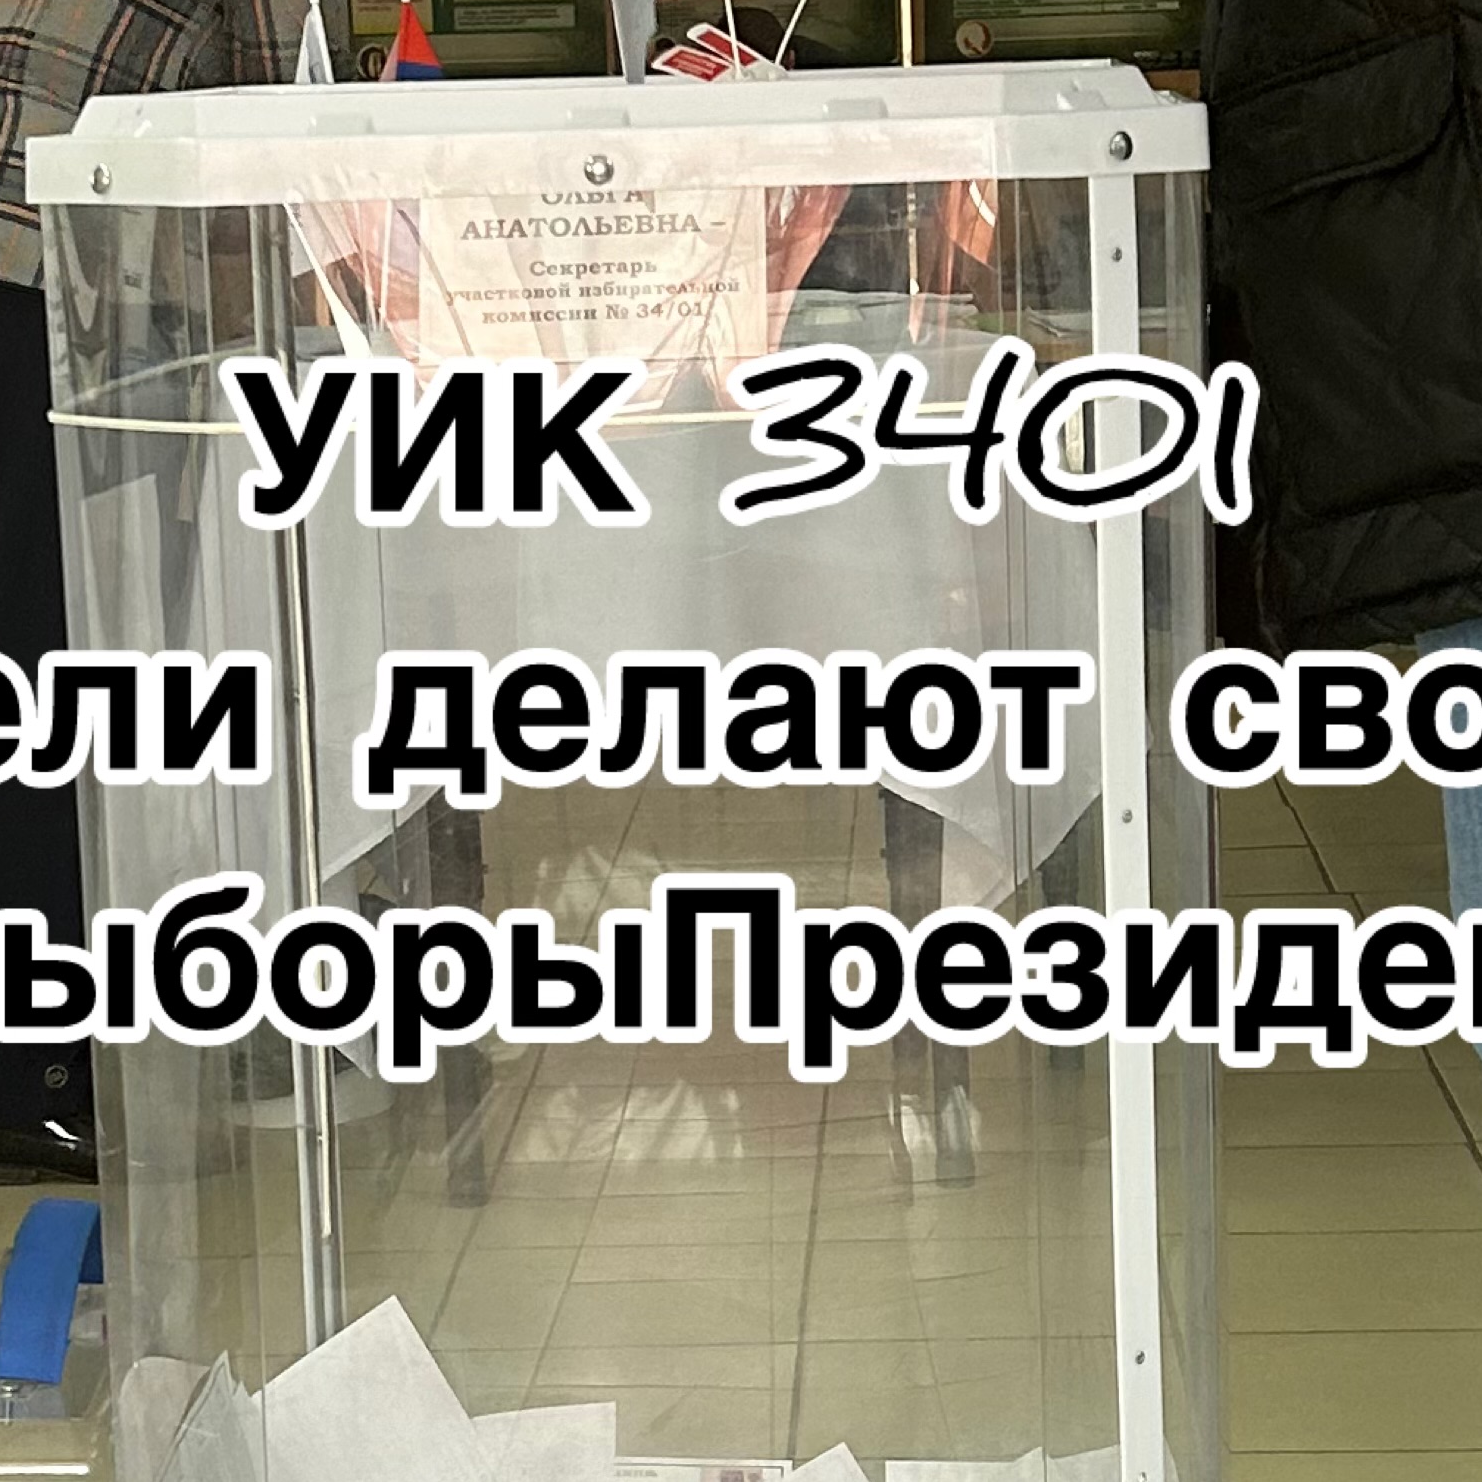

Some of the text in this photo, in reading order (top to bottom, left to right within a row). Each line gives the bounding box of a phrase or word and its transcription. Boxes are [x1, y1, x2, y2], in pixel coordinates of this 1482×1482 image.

[460, 213, 702, 240] АНАТОЛЬЕВНА
[530, 260, 658, 280] Секретарь
[482, 301, 704, 325] комиссии № 34/01
